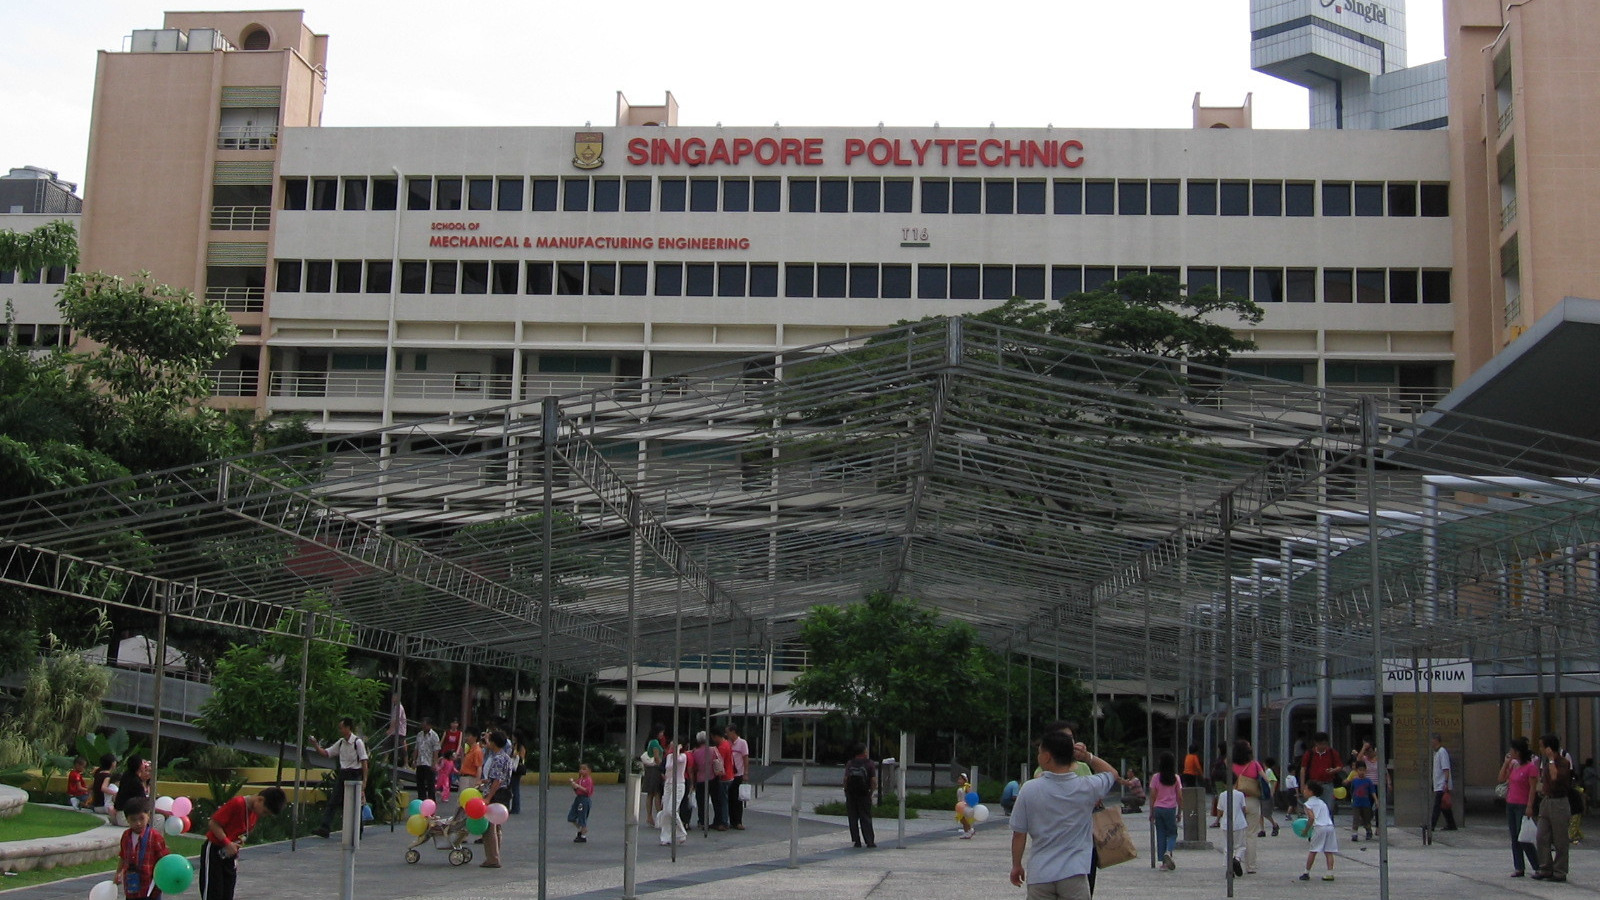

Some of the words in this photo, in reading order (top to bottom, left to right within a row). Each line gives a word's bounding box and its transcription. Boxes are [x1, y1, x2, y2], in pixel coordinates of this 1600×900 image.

[1344, 0, 1387, 25] SingTel
[627, 137, 824, 166] SINGAPORE
[845, 138, 1084, 168] POLYTECHNIC
[431, 222, 466, 230] SCHOOL
[468, 222, 480, 230] OF
[902, 227, 929, 241] T16
[429, 236, 519, 248] MECHANICAL
[523, 236, 532, 248] &
[536, 236, 654, 249] MANUFACTURING
[658, 237, 750, 250] ENGINEERING
[1387, 670, 1465, 681] AUDTORIUM
